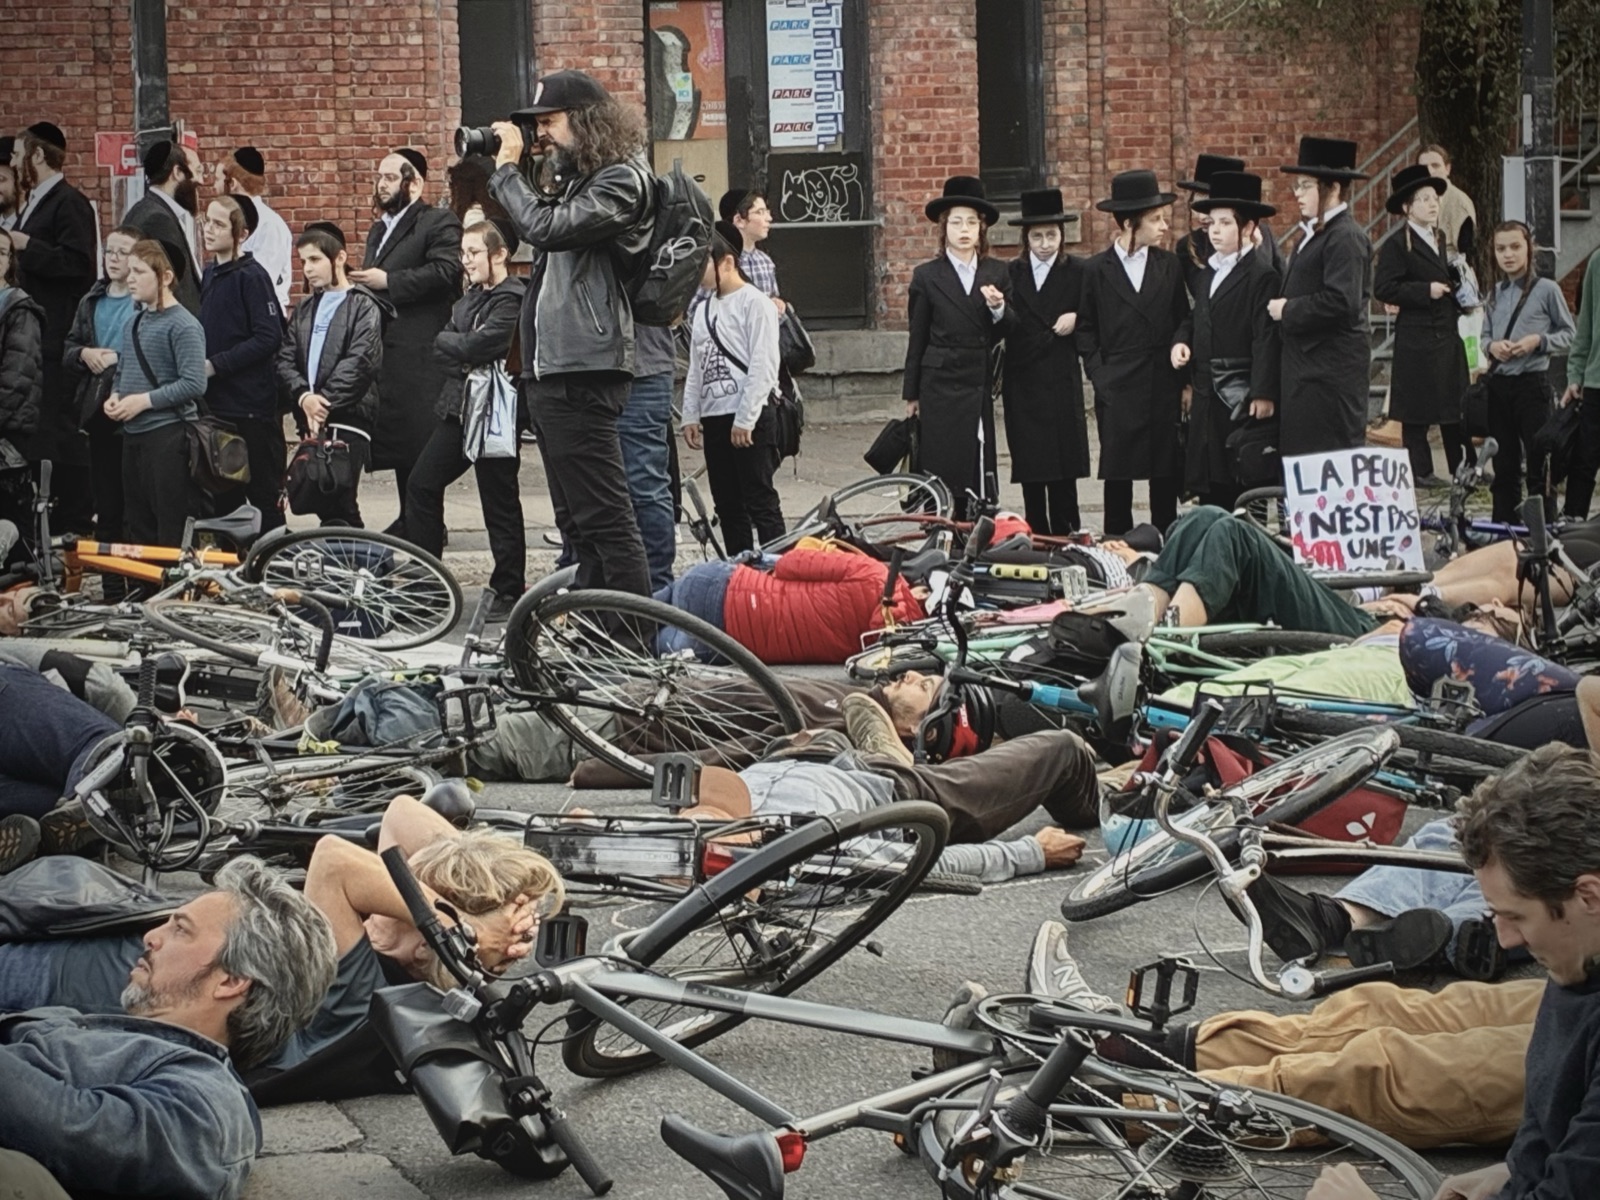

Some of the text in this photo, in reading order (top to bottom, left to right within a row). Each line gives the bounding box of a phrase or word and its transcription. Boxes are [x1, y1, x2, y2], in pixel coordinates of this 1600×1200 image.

[771, 20, 809, 30] PARC
[772, 55, 811, 65] PARC
[773, 89, 812, 99] PARC
[774, 122, 813, 132] PARC
[1293, 453, 1410, 495] LA PEUR
[1387, 504, 1418, 533] PAS
[1347, 536, 1395, 560] UNE
